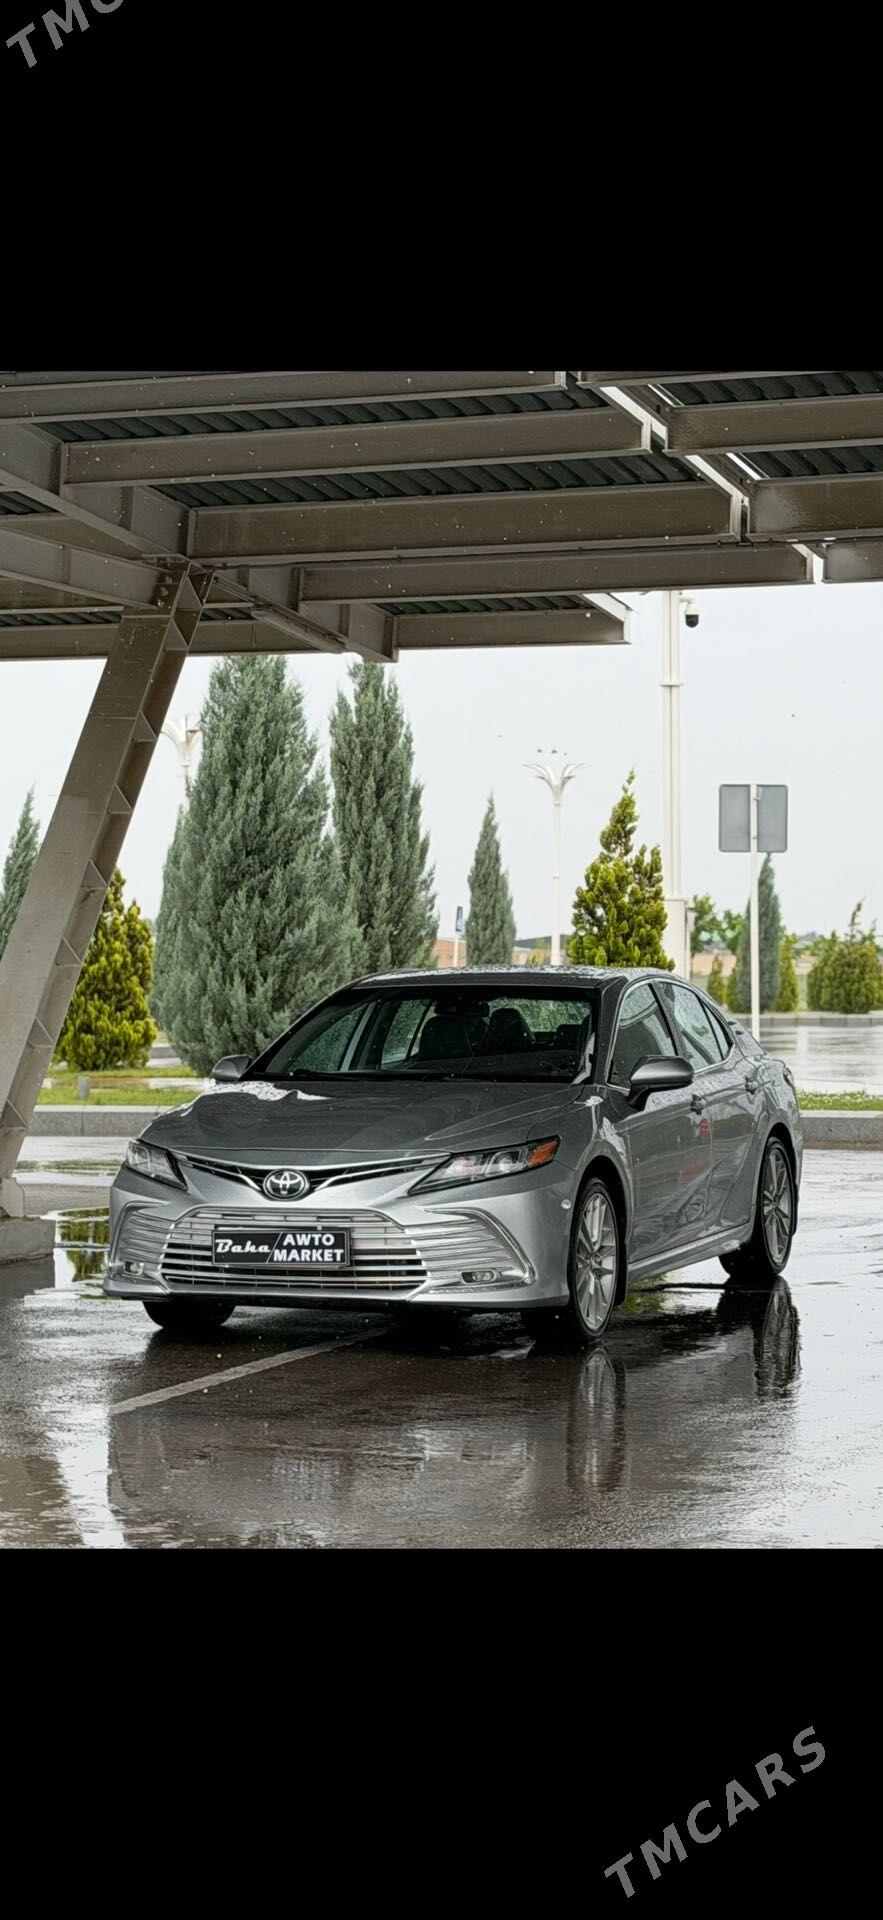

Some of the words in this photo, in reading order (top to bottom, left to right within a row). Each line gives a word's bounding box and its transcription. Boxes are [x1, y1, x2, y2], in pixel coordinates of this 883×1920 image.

[215, 1239, 271, 1253] Baka
[283, 1233, 335, 1247] AWTO
[273, 1248, 344, 1262] MARKET
